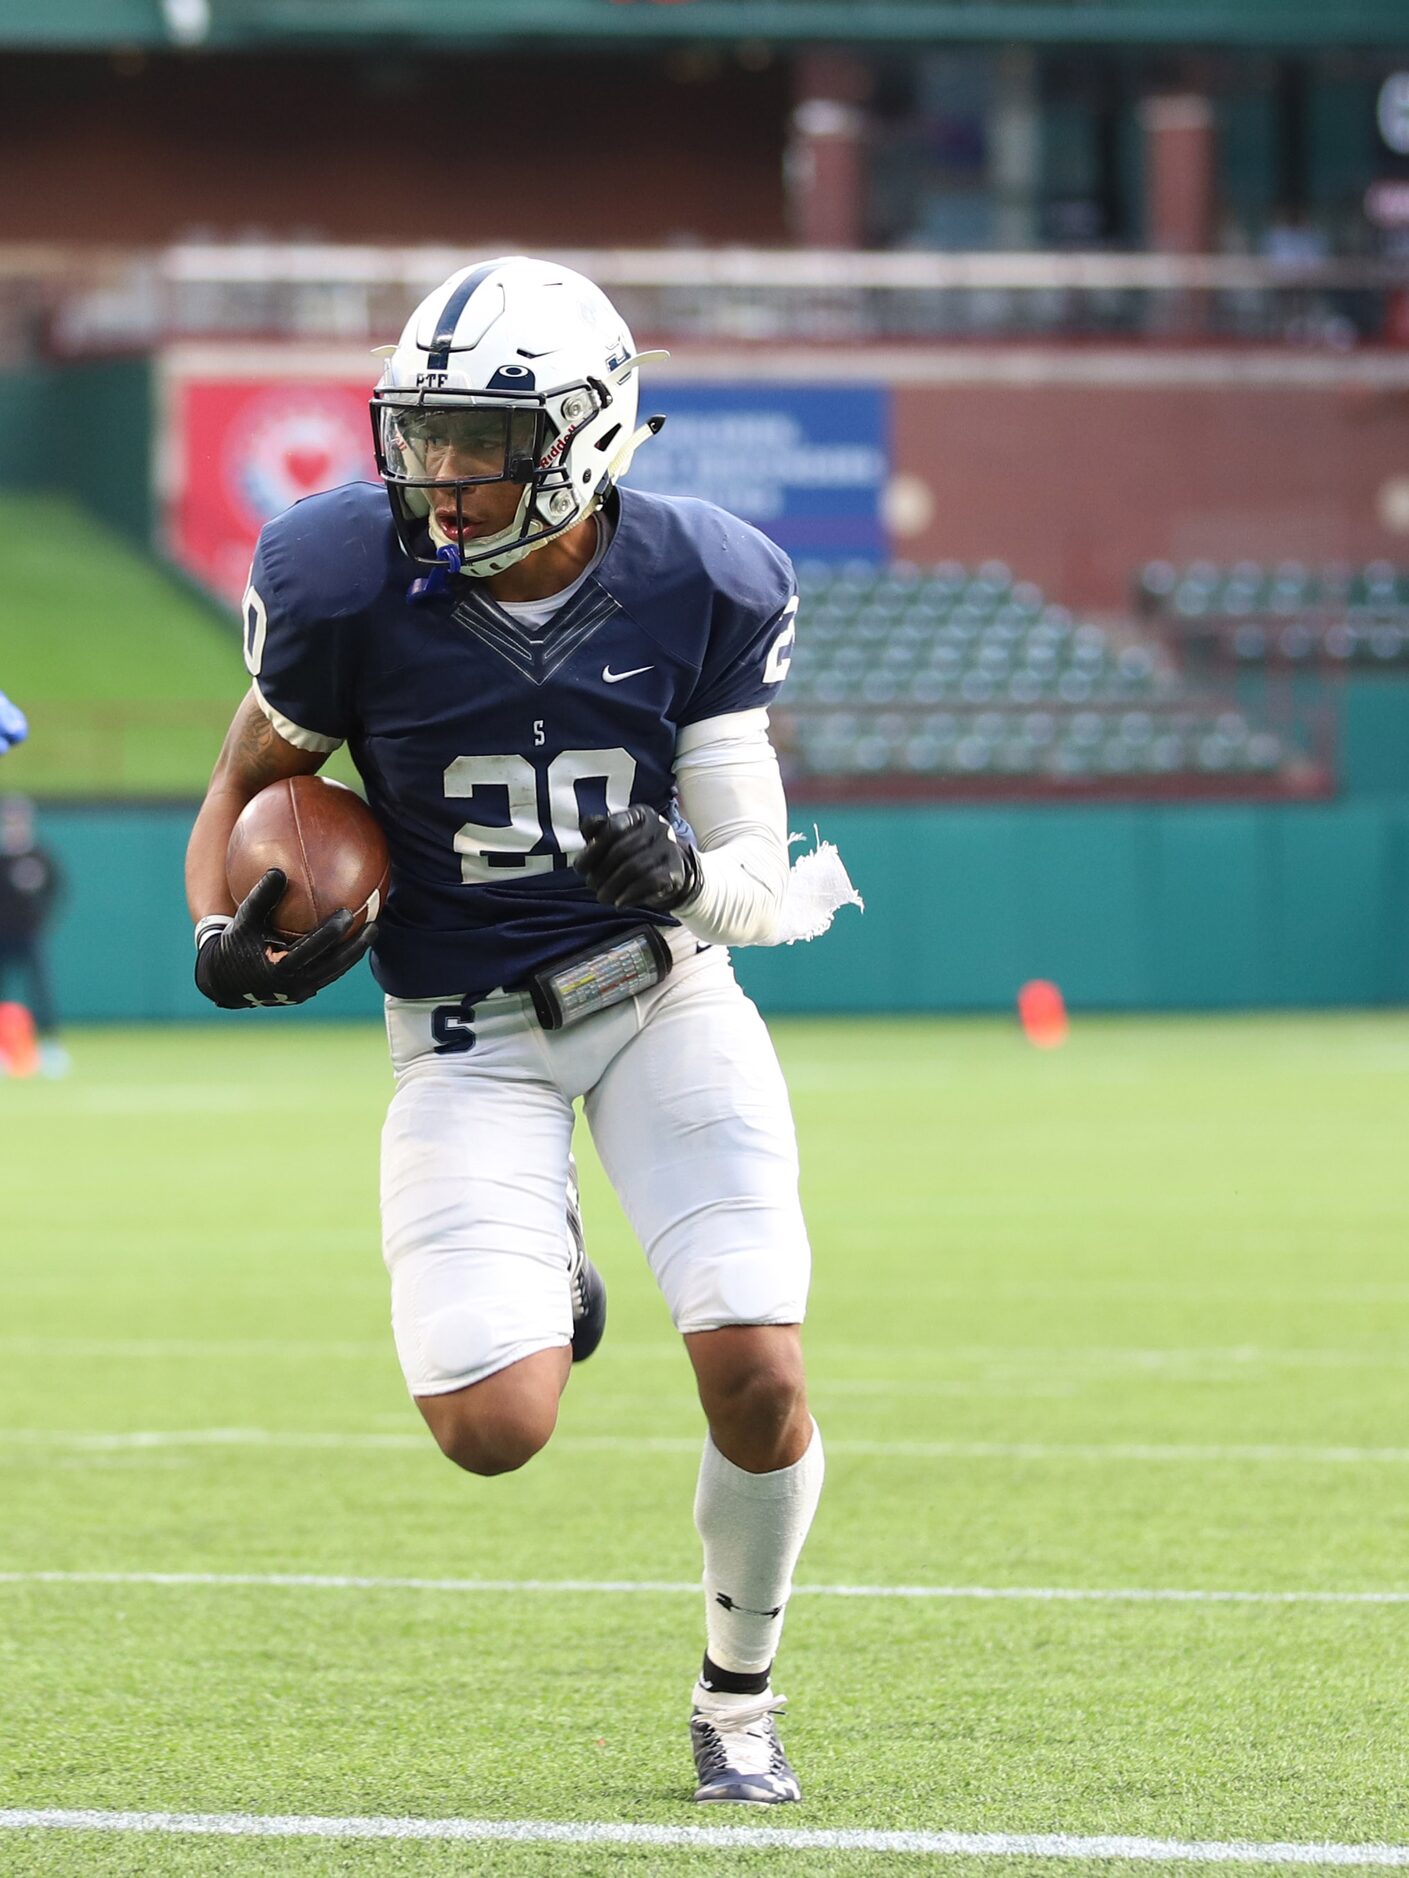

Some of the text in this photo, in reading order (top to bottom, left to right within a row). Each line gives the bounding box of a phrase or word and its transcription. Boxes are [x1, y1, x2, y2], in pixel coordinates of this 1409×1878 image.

[533, 719, 546, 747] S
[443, 747, 638, 885] 20
[431, 1004, 477, 1055] S
